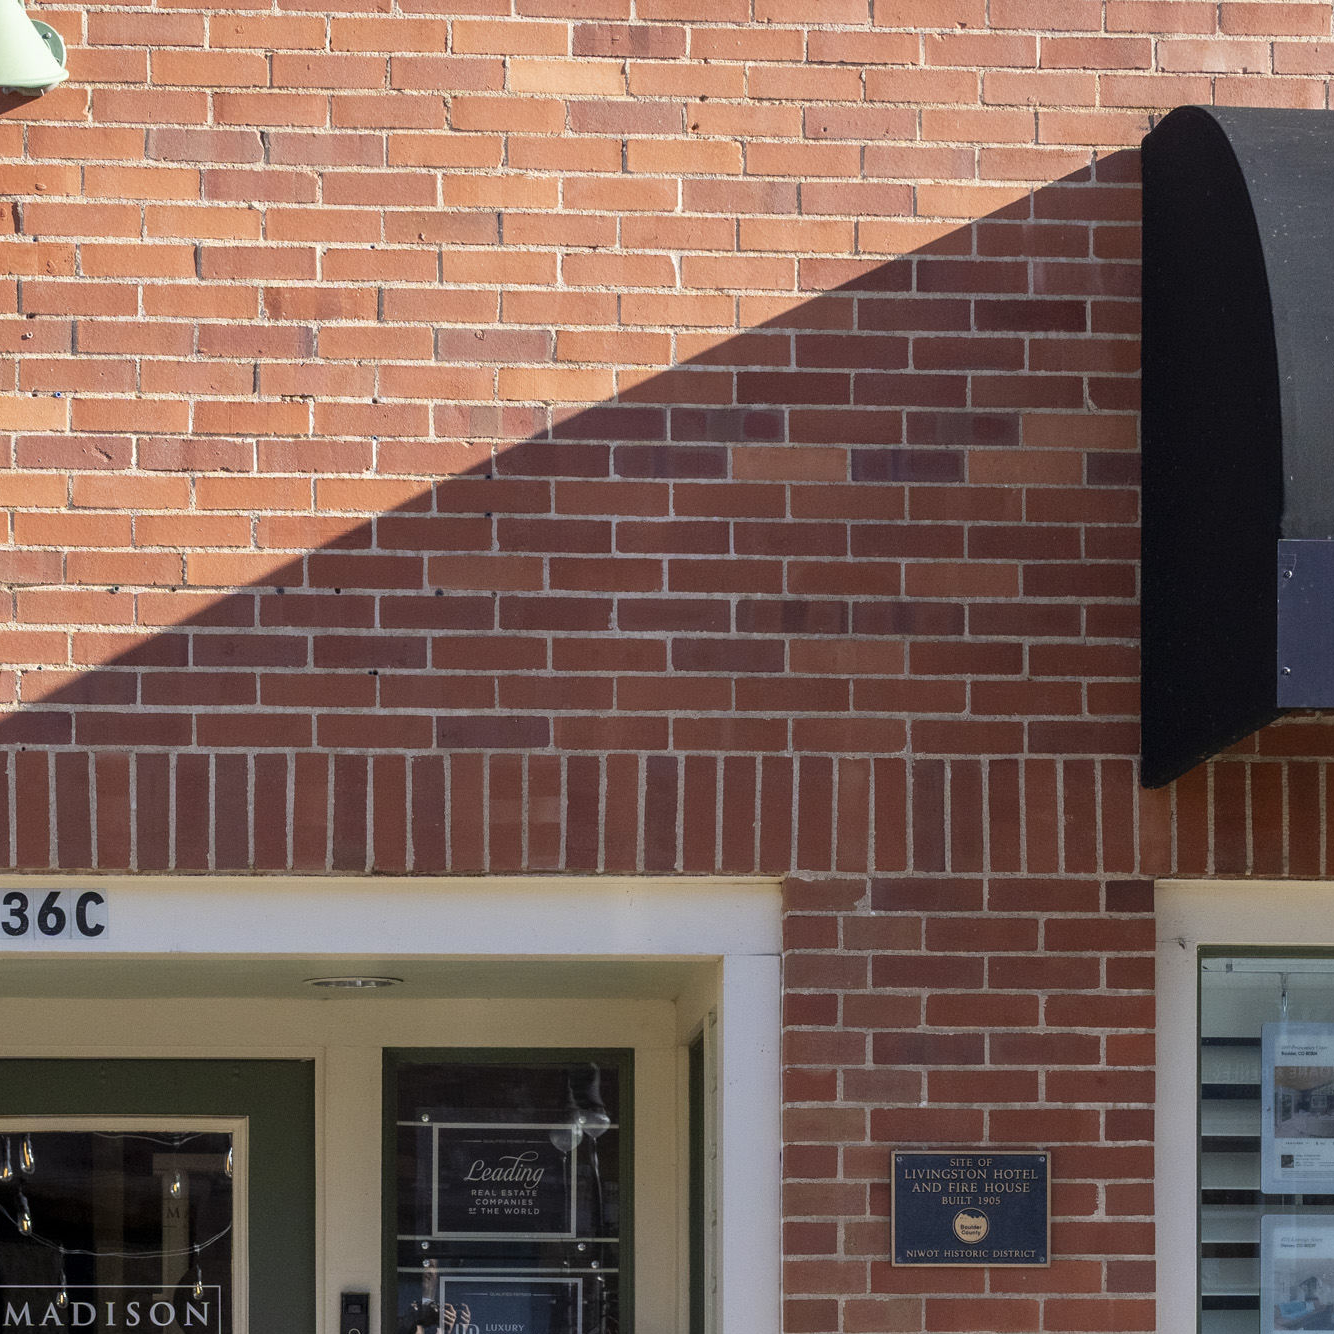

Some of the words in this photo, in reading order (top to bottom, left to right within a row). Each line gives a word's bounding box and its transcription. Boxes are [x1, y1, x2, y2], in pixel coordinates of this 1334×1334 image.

[949, 1158, 973, 1166] SITE
[977, 1158, 993, 1166] OF
[463, 1150, 545, 1189] Leading
[905, 1170, 987, 1180] LIVINGSTON
[993, 1170, 1039, 1180] HOTEL
[912, 1183, 941, 1192] AND
[949, 1183, 978, 1192] FIRE
[984, 1183, 1031, 1192] HOUSE
[942, 1196, 973, 1205] BUILT
[978, 1196, 1001, 1205] 1905
[906, 1250, 939, 1258] NIWOT
[944, 1250, 989, 1258] HISTORIC
[993, 1250, 1037, 1258] DISTRICT
[2, 1301, 210, 1326] MADISON
[485, 1324, 525, 1332] LUXURY
